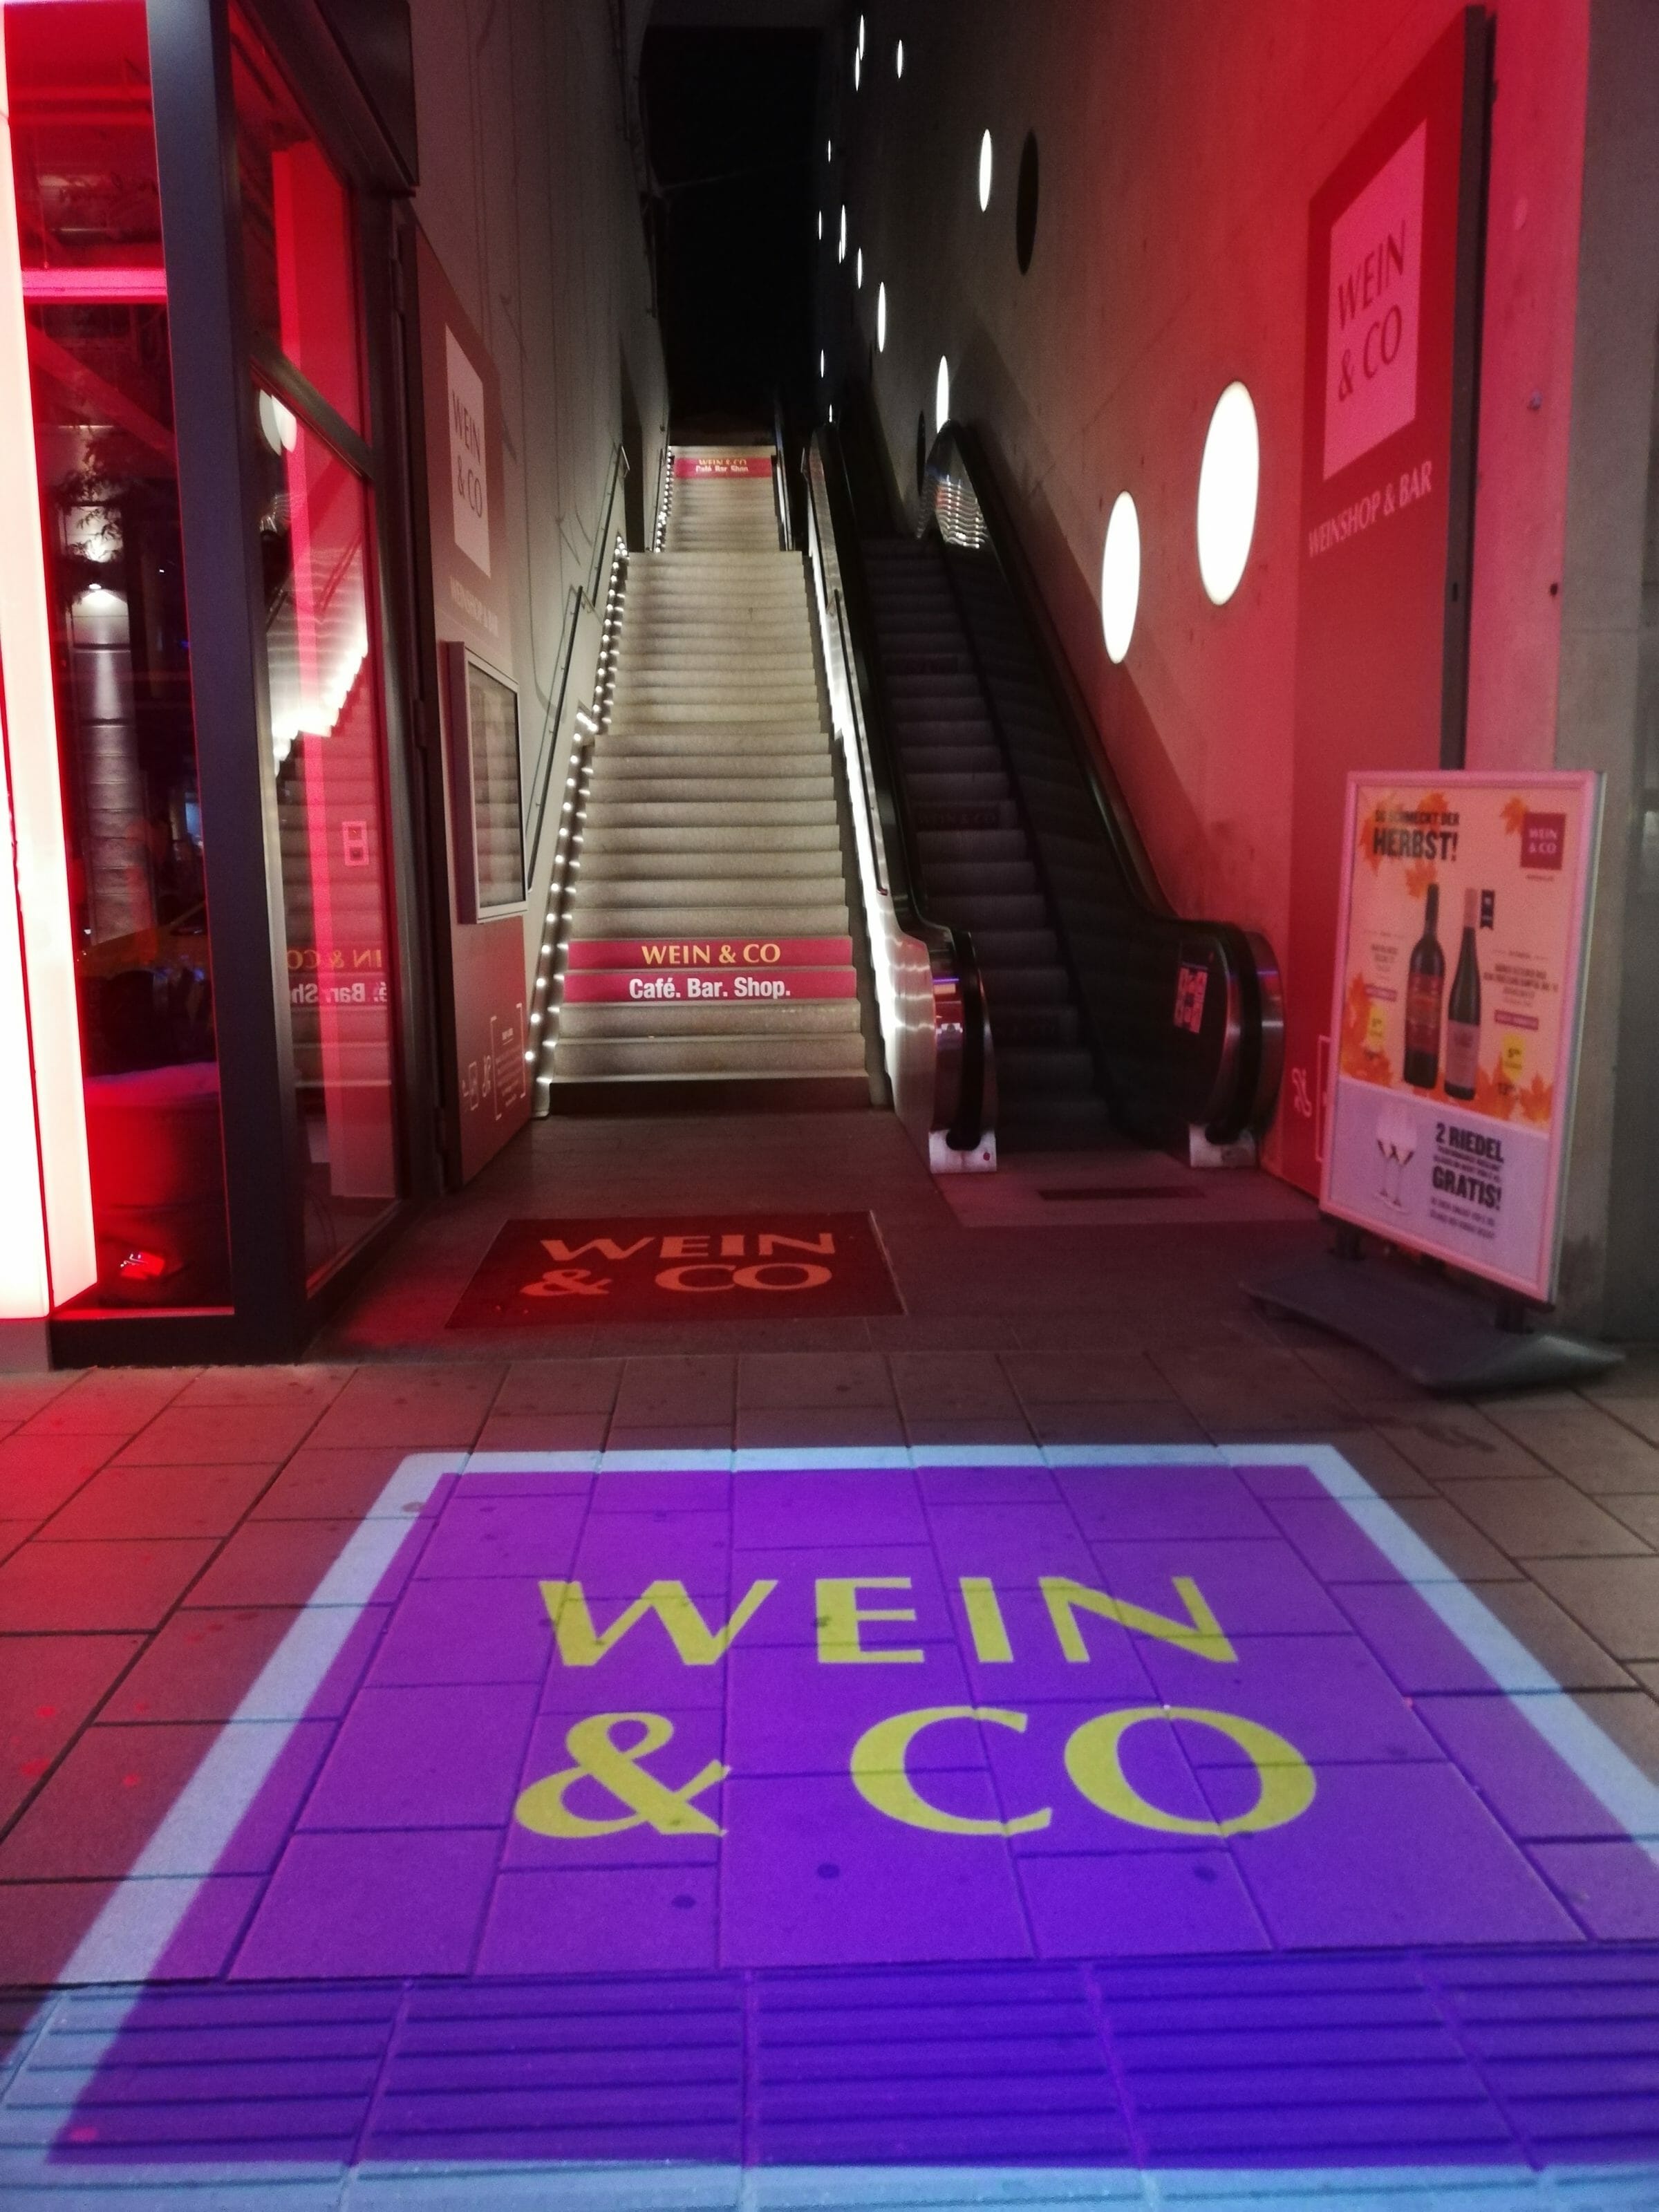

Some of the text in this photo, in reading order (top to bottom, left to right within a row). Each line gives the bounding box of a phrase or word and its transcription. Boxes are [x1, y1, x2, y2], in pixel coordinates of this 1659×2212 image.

[1338, 218, 1406, 331] WEIN
[1338, 304, 1403, 402] & CO
[452, 390, 481, 465] WEIN
[458, 454, 483, 518] & CO
[1309, 460, 1432, 558] WEINSHOP & BAR
[1373, 827, 1459, 863] HERBST!
[1528, 827, 1557, 841] WEIN
[1538, 843, 1557, 855] CO
[641, 943, 781, 965] WEIN & CO
[629, 977, 791, 1000] Café. Bar. Shop.
[1436, 1122, 1446, 1144] 2
[1449, 1125, 1504, 1163] RIEDEL
[1432, 1165, 1502, 1211] GRATIS!
[540, 1232, 836, 1261] WEIN
[519, 1262, 832, 1297] & CO
[538, 1576, 1239, 1667] WEIN
[514, 1705, 1318, 1839] & CO
